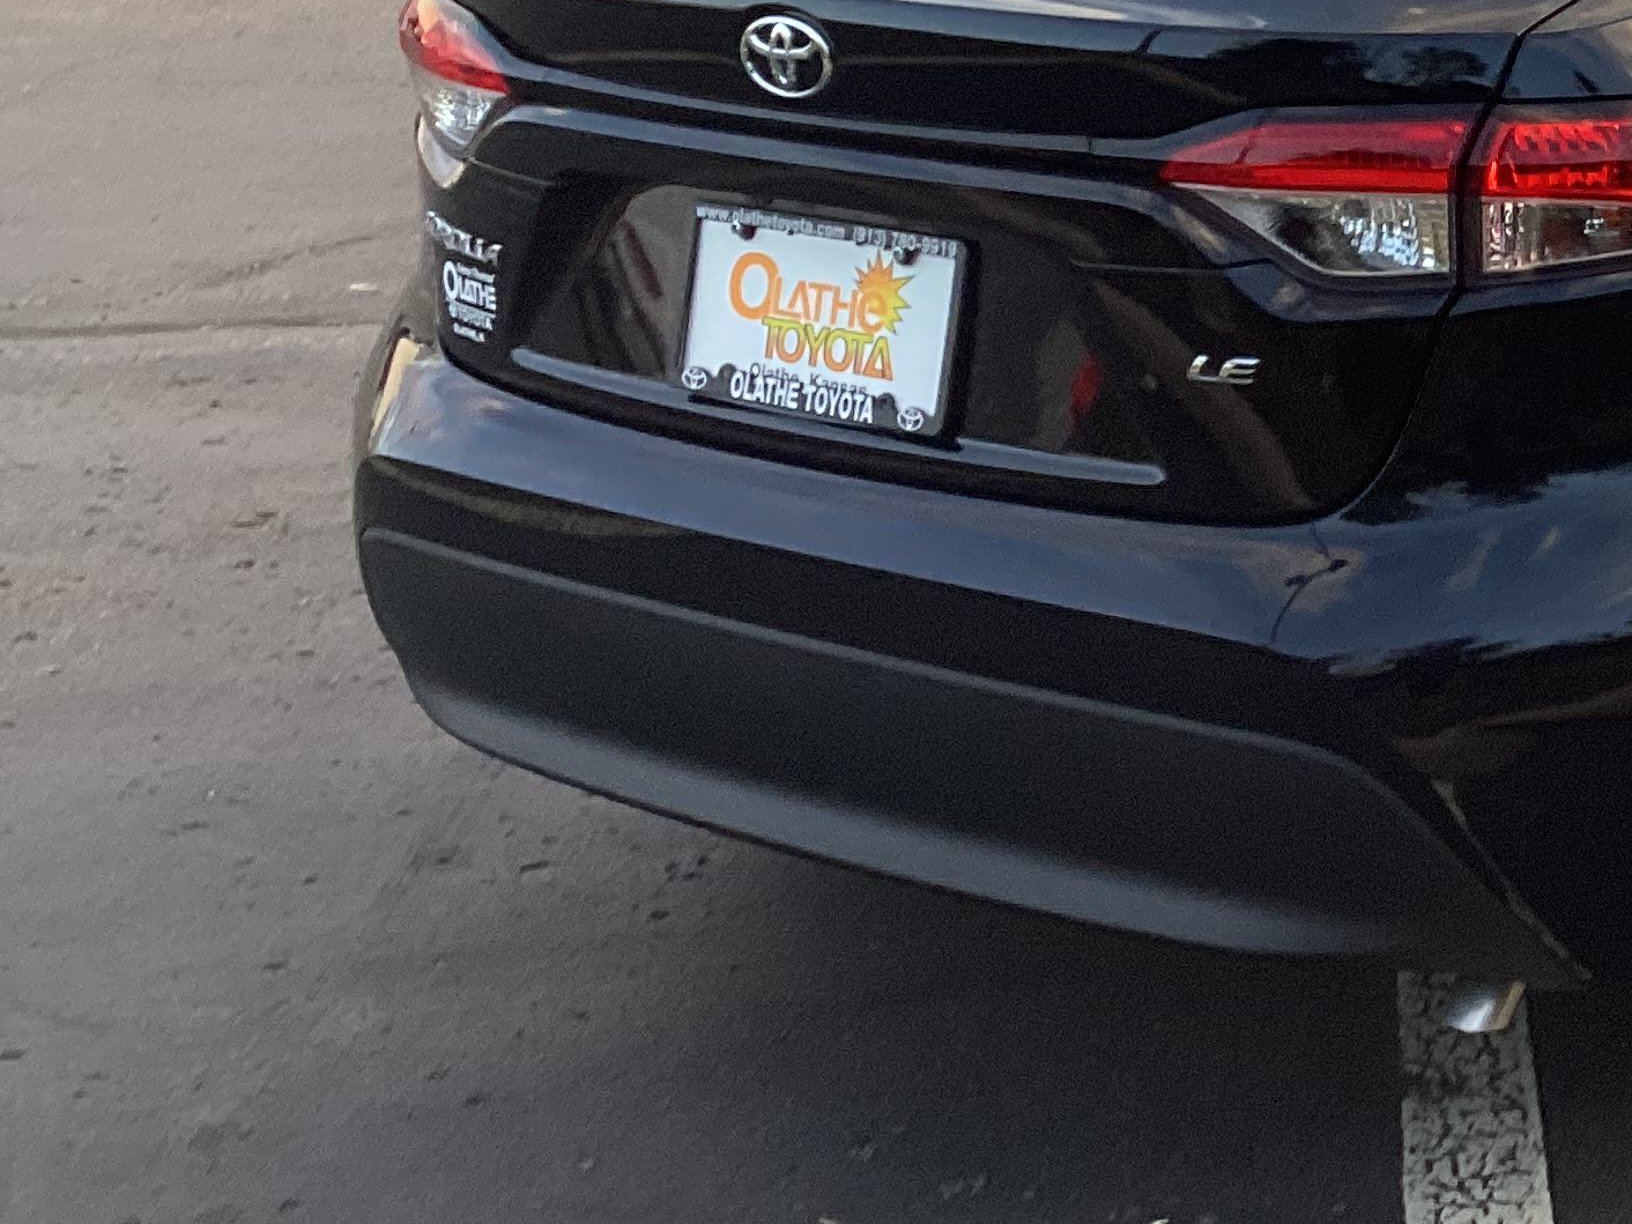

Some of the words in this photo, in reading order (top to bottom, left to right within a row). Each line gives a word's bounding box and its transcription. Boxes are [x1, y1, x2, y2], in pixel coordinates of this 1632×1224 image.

[761, 316, 894, 381] TOYOTA
[1186, 355, 1261, 386] LE
[730, 370, 799, 410] OLATHE
[802, 384, 874, 425] TOYOTA
